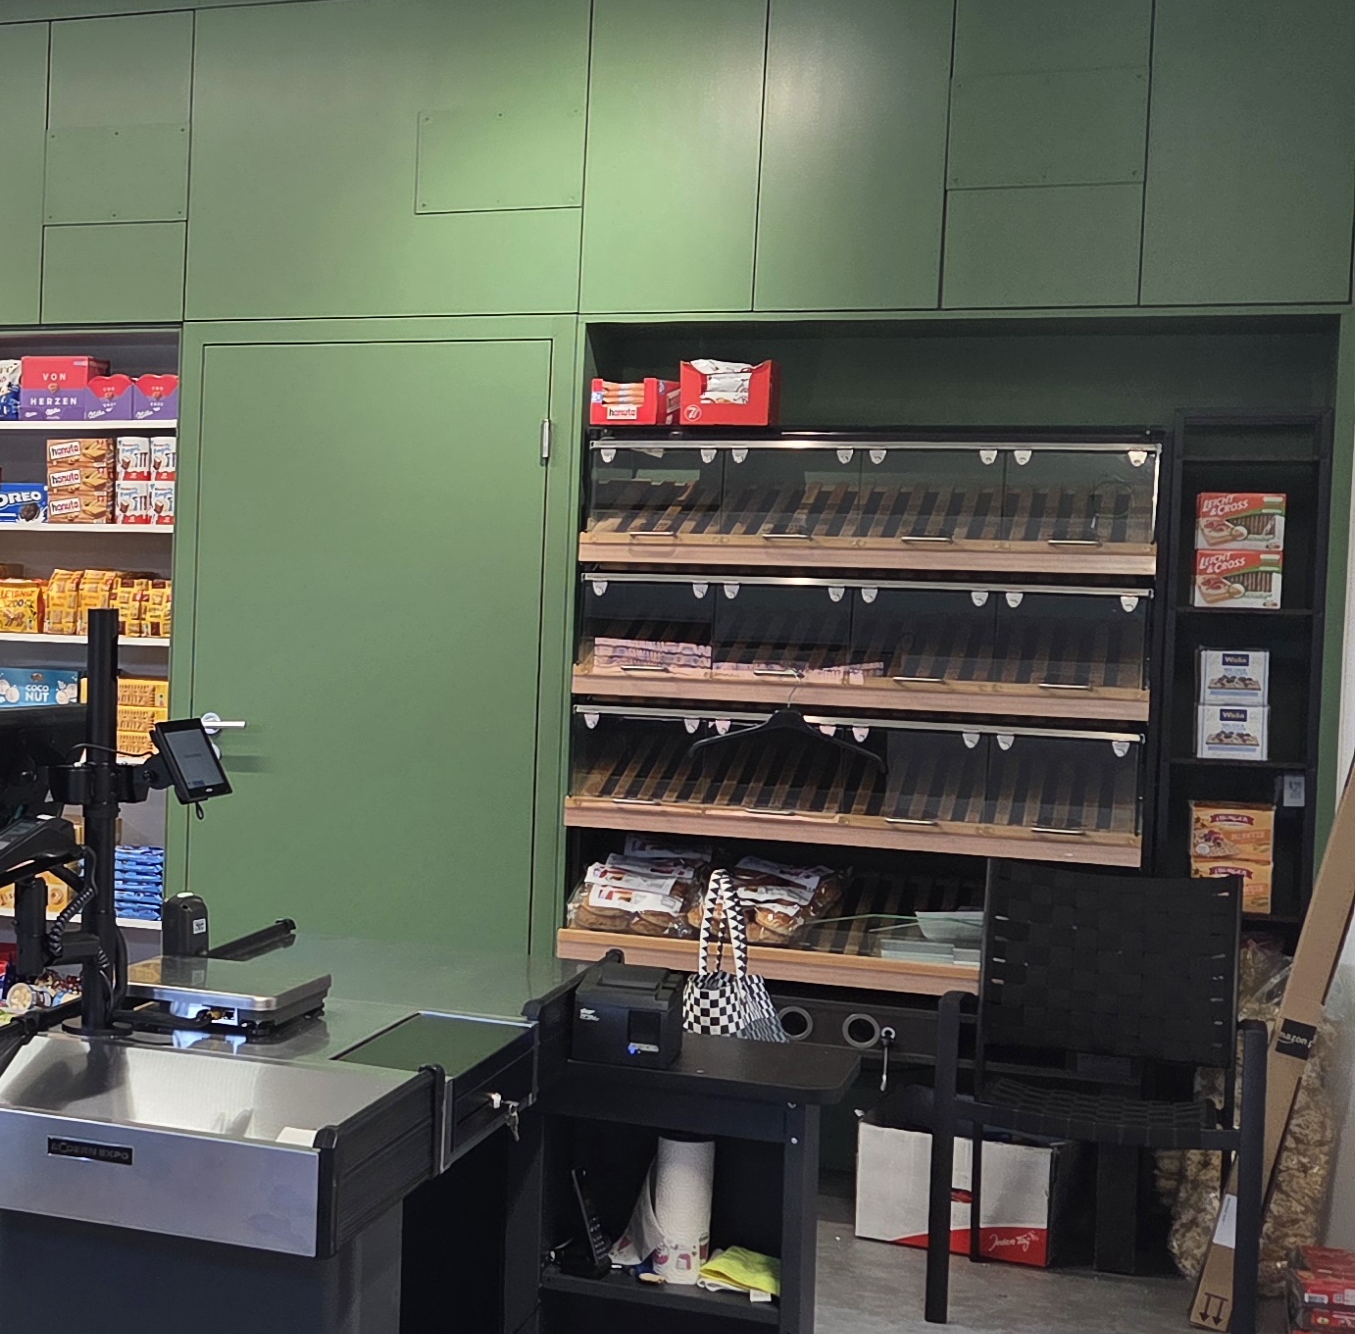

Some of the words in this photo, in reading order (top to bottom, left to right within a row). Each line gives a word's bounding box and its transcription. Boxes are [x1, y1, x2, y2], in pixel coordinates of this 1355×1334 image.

[42, 373, 67, 381] VON
[30, 397, 77, 406] HERZEN
[51, 444, 79, 457] hanuta
[51, 473, 79, 484] hanuta
[51, 501, 79, 513] hanuta
[25, 684, 50, 692] COCO
[25, 692, 50, 702] NUT
[99, 1150, 129, 1160] EXPO
[988, 1233, 1016, 1252] Jeden
